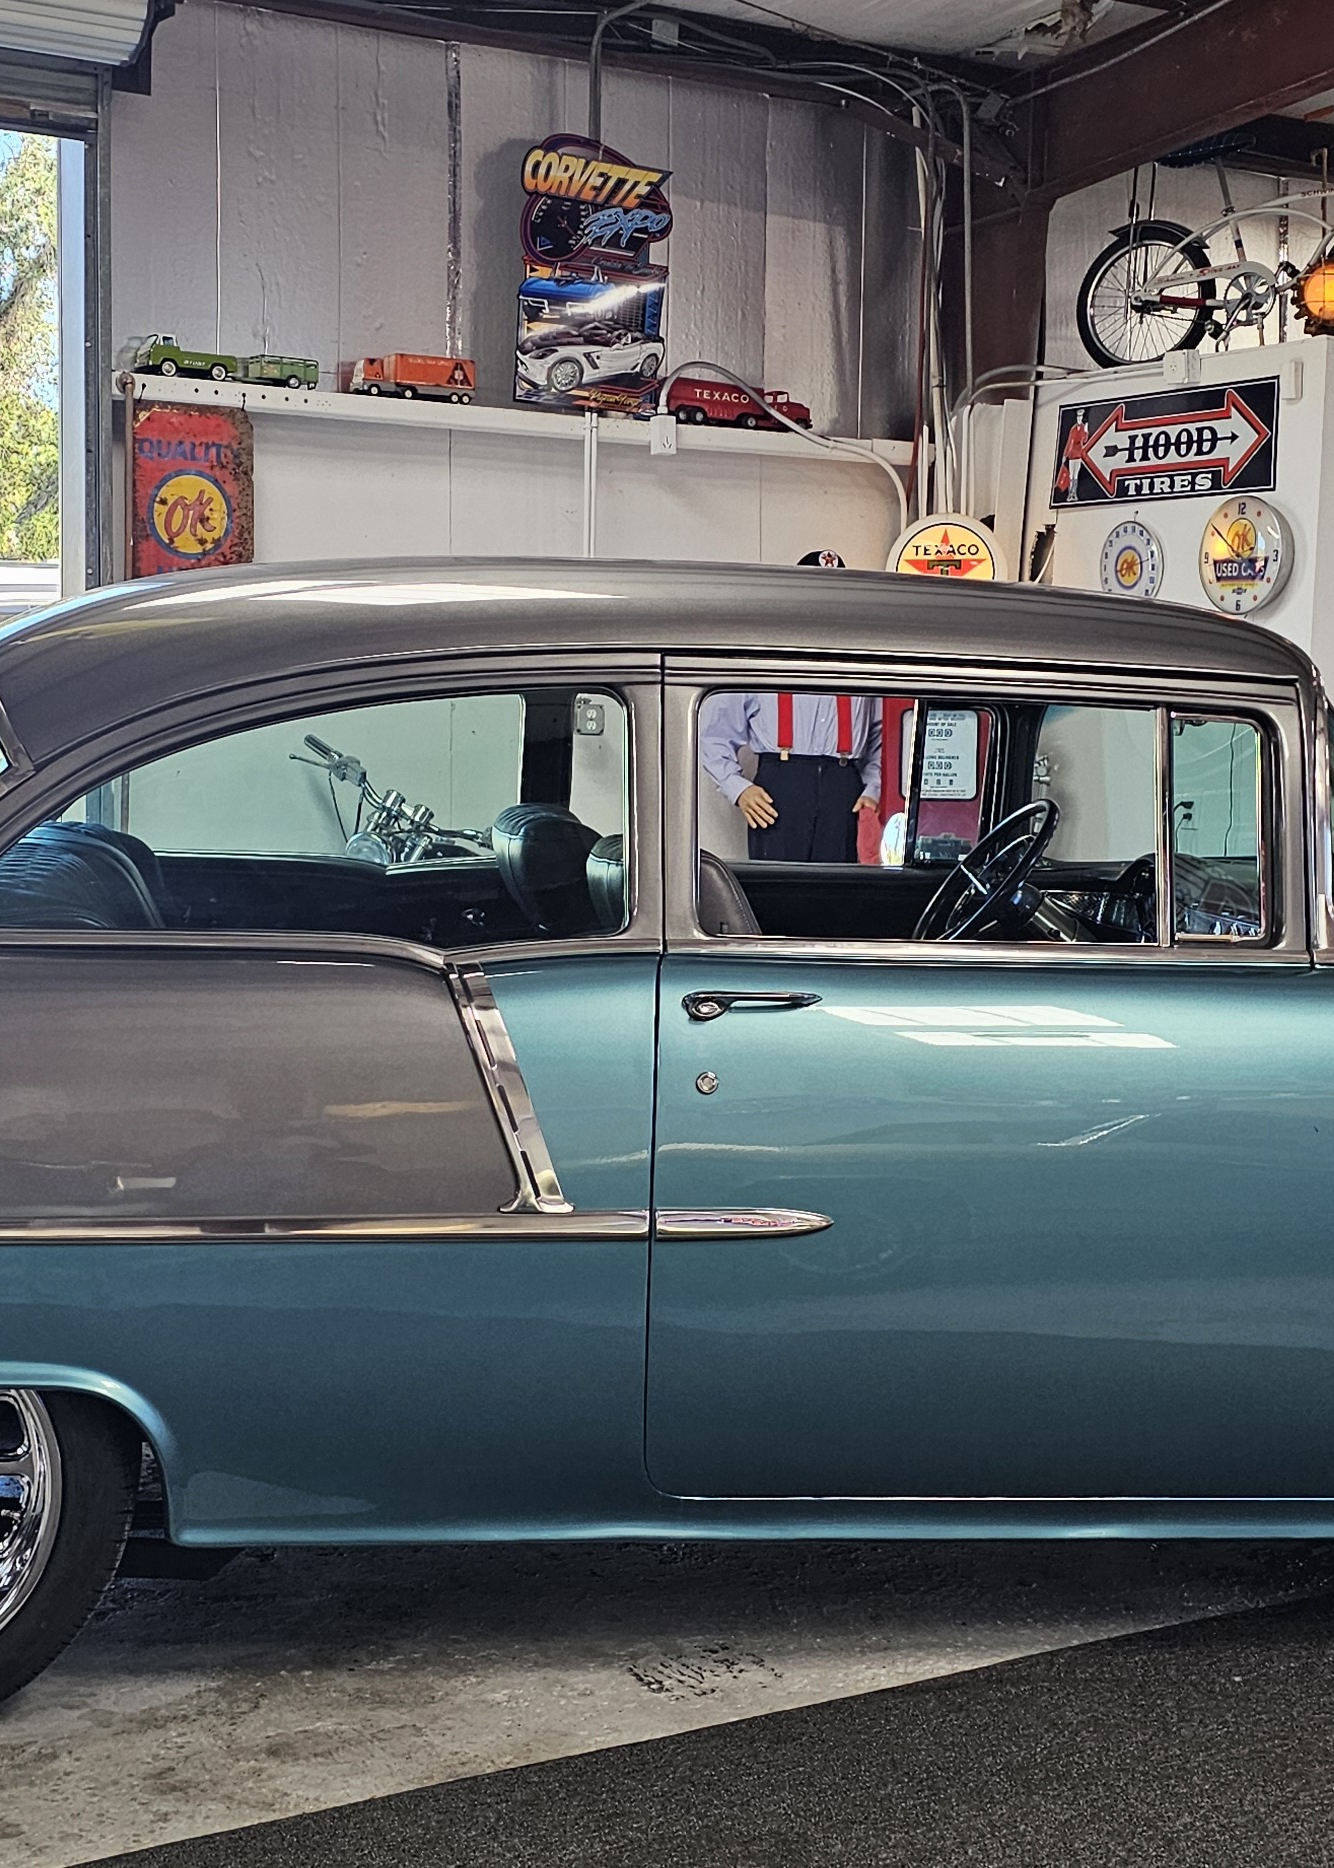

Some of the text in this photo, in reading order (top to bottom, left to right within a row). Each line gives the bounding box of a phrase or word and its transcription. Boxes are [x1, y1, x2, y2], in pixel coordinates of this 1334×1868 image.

[524, 149, 663, 208] CORVETTE
[583, 207, 670, 248] EXPO
[694, 389, 749, 404] TEXACO
[1125, 426, 1218, 463] HOOD
[1124, 473, 1213, 496] TIRES
[164, 489, 217, 538] OK
[1238, 502, 1247, 516] 12
[912, 544, 980, 556] TEXACO
[1273, 549, 1279, 562] 3
[1216, 562, 1239, 577] USED
[1235, 600, 1241, 612] 6
